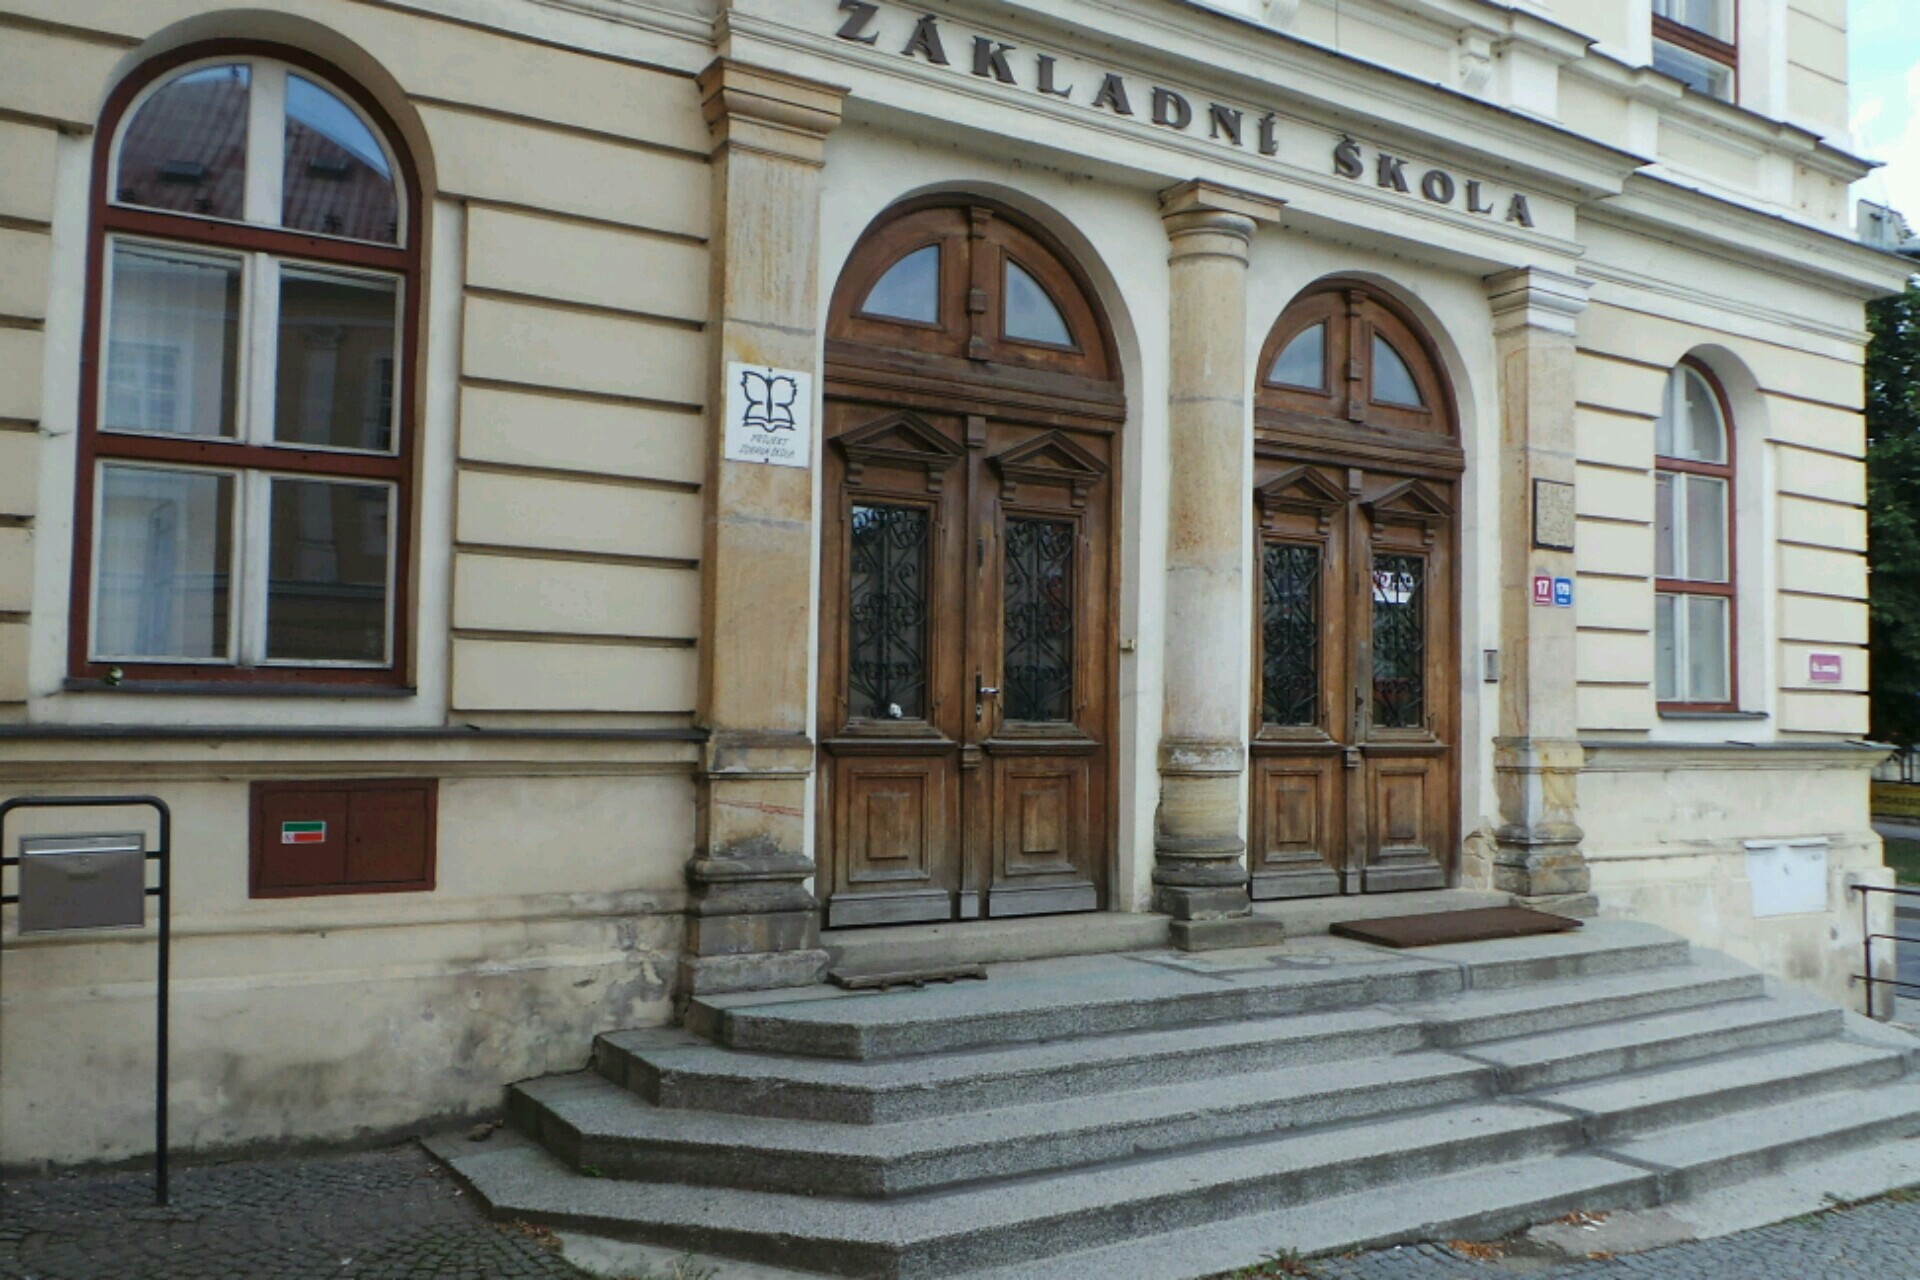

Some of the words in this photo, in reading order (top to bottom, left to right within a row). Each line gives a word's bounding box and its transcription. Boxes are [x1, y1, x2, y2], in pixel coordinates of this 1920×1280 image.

[835, 0, 1278, 156] ZÁKLADNÍ
[1333, 133, 1536, 228] ŠKOLA
[1536, 580, 1550, 595] 17
